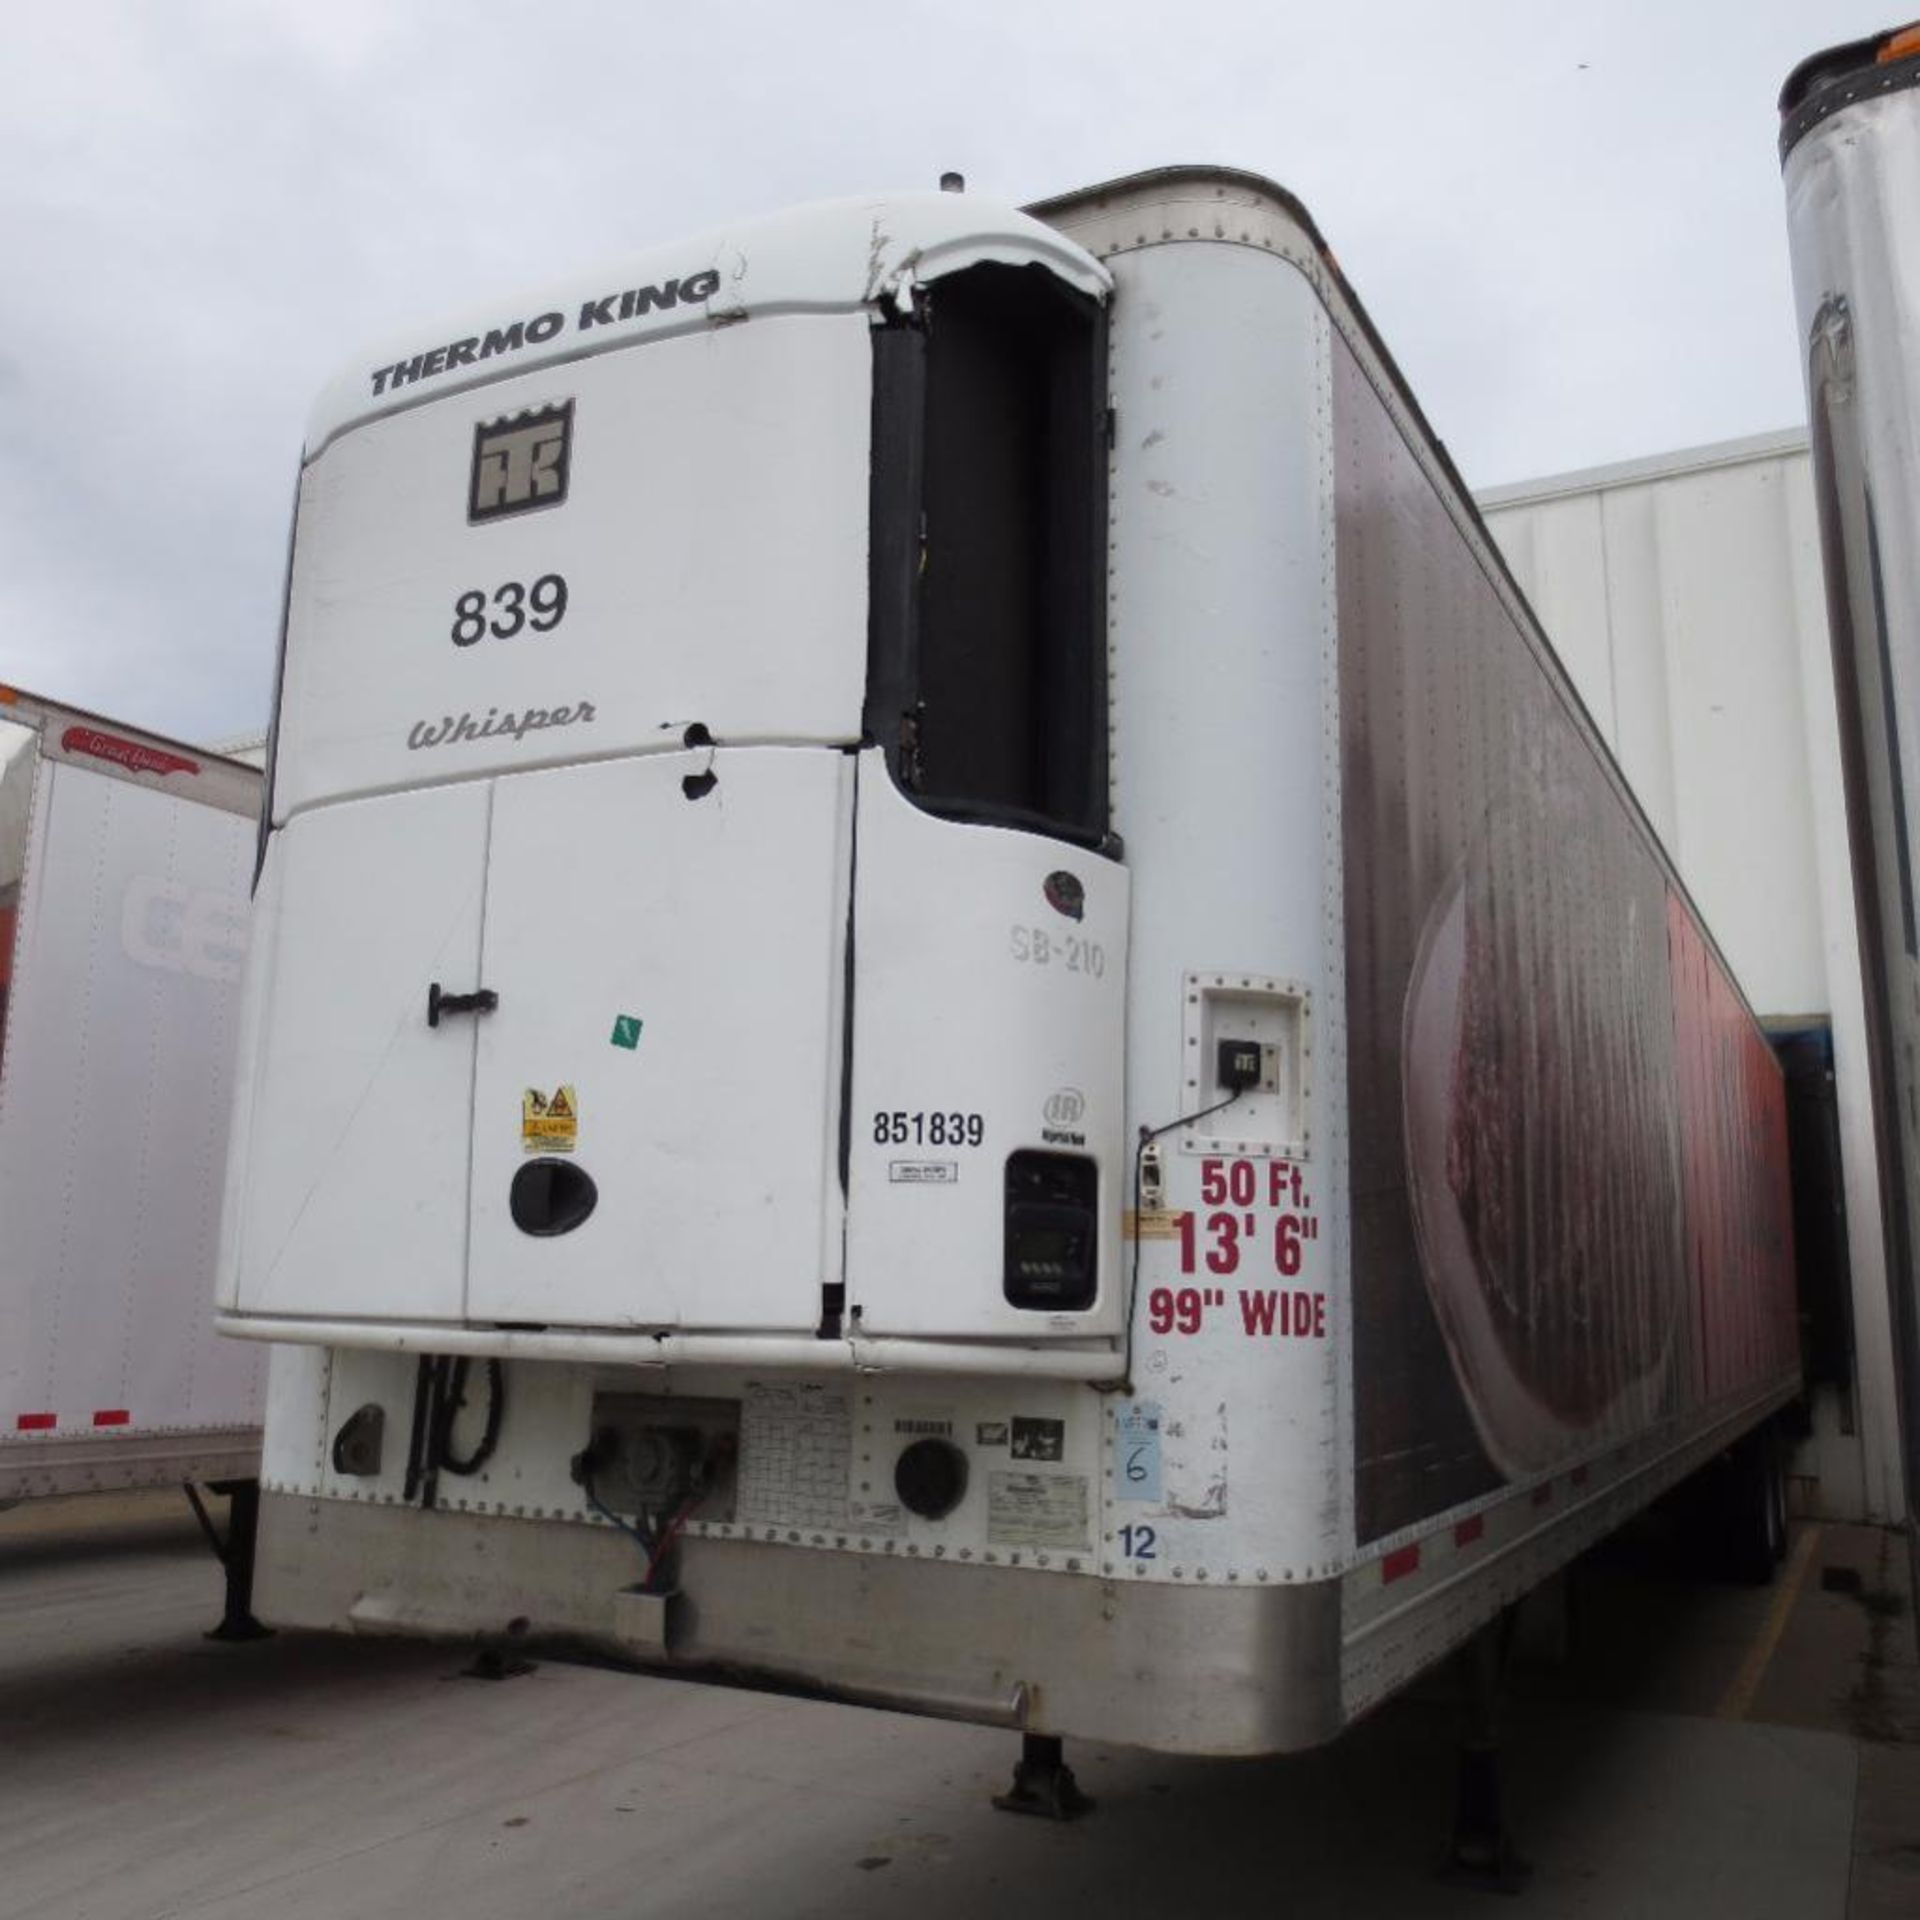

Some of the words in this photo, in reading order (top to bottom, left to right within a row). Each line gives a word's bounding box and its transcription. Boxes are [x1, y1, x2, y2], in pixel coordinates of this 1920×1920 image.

[370, 312, 566, 397] THERMO
[578, 269, 721, 331] KING
[450, 572, 568, 648] 839
[406, 700, 598, 753] Whisper
[1009, 924, 1106, 979] SB-210
[872, 1110, 985, 1148] 851839
[1200, 1159, 1256, 1208] 50
[1268, 1160, 1311, 1209] Ft.
[1172, 1211, 1255, 1275] 13'
[1274, 1213, 1319, 1277] 6"
[1148, 1287, 1224, 1336] 99"
[1239, 1289, 1326, 1339] WIDE
[1117, 1524, 1157, 1560] 12
